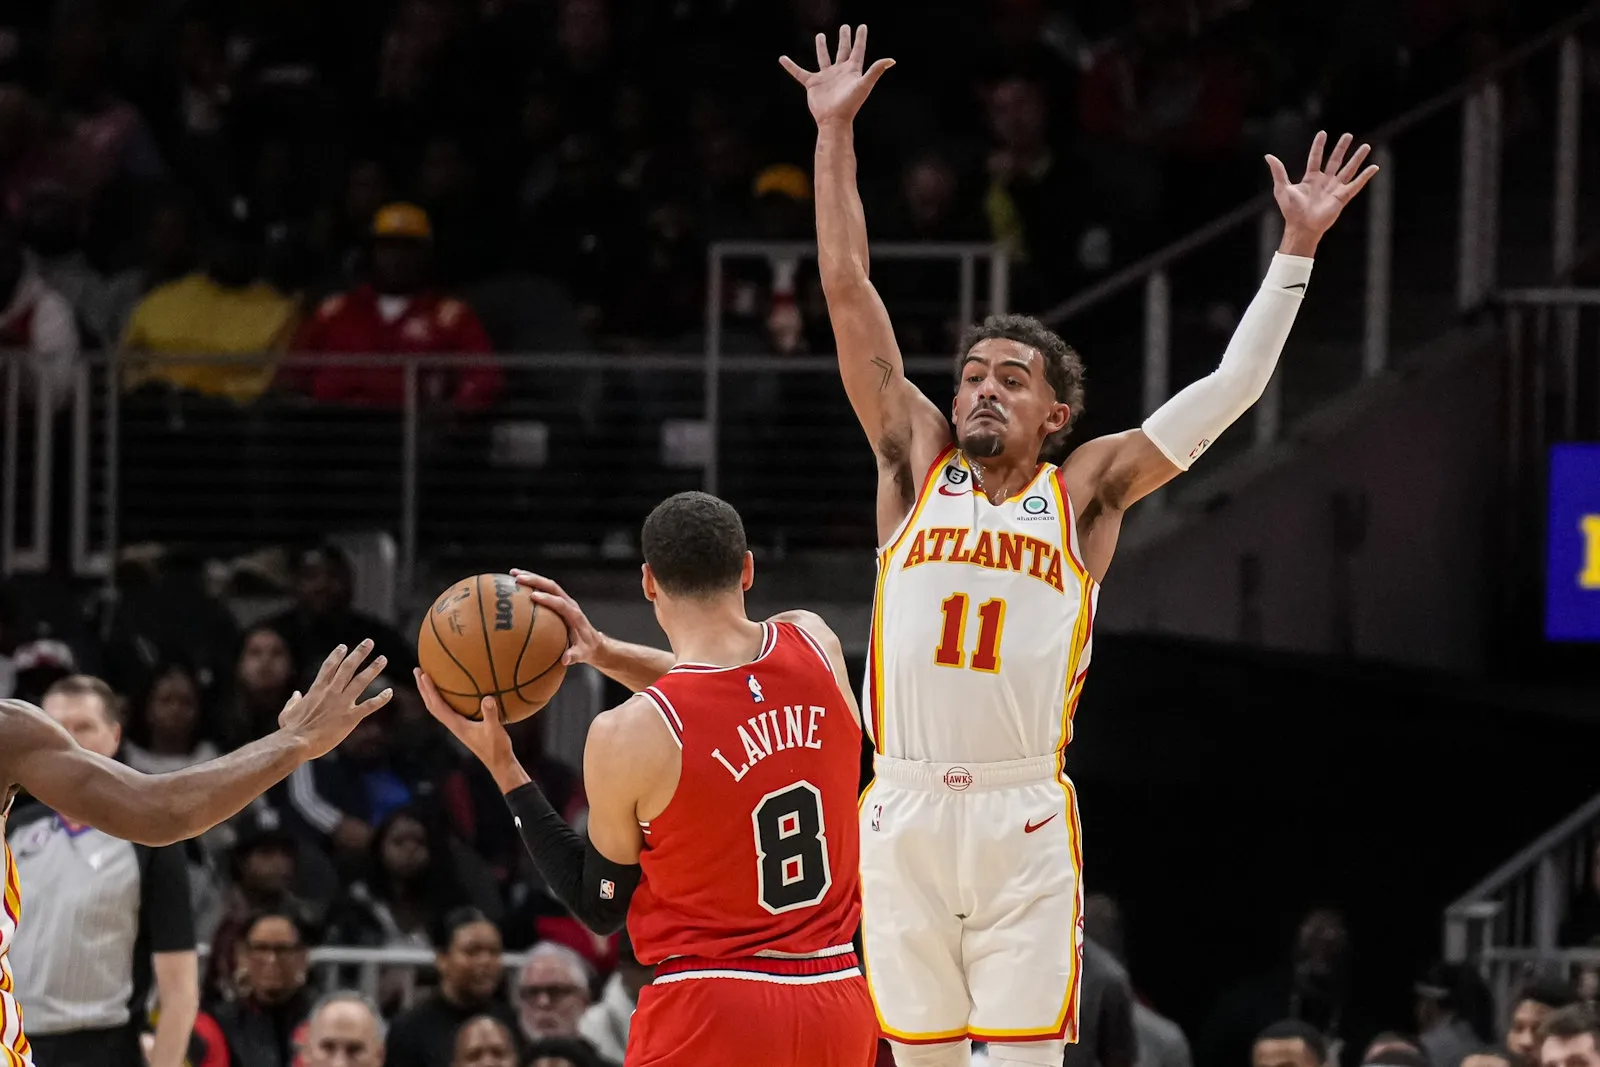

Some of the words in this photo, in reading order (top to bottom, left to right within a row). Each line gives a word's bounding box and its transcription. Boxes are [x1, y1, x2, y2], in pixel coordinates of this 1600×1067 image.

[901, 526, 1065, 594] ATLANTA
[934, 592, 1007, 675] 11
[711, 704, 826, 783] LAVINE
[943, 775, 973, 784] HAWKS
[751, 779, 833, 915] 8
